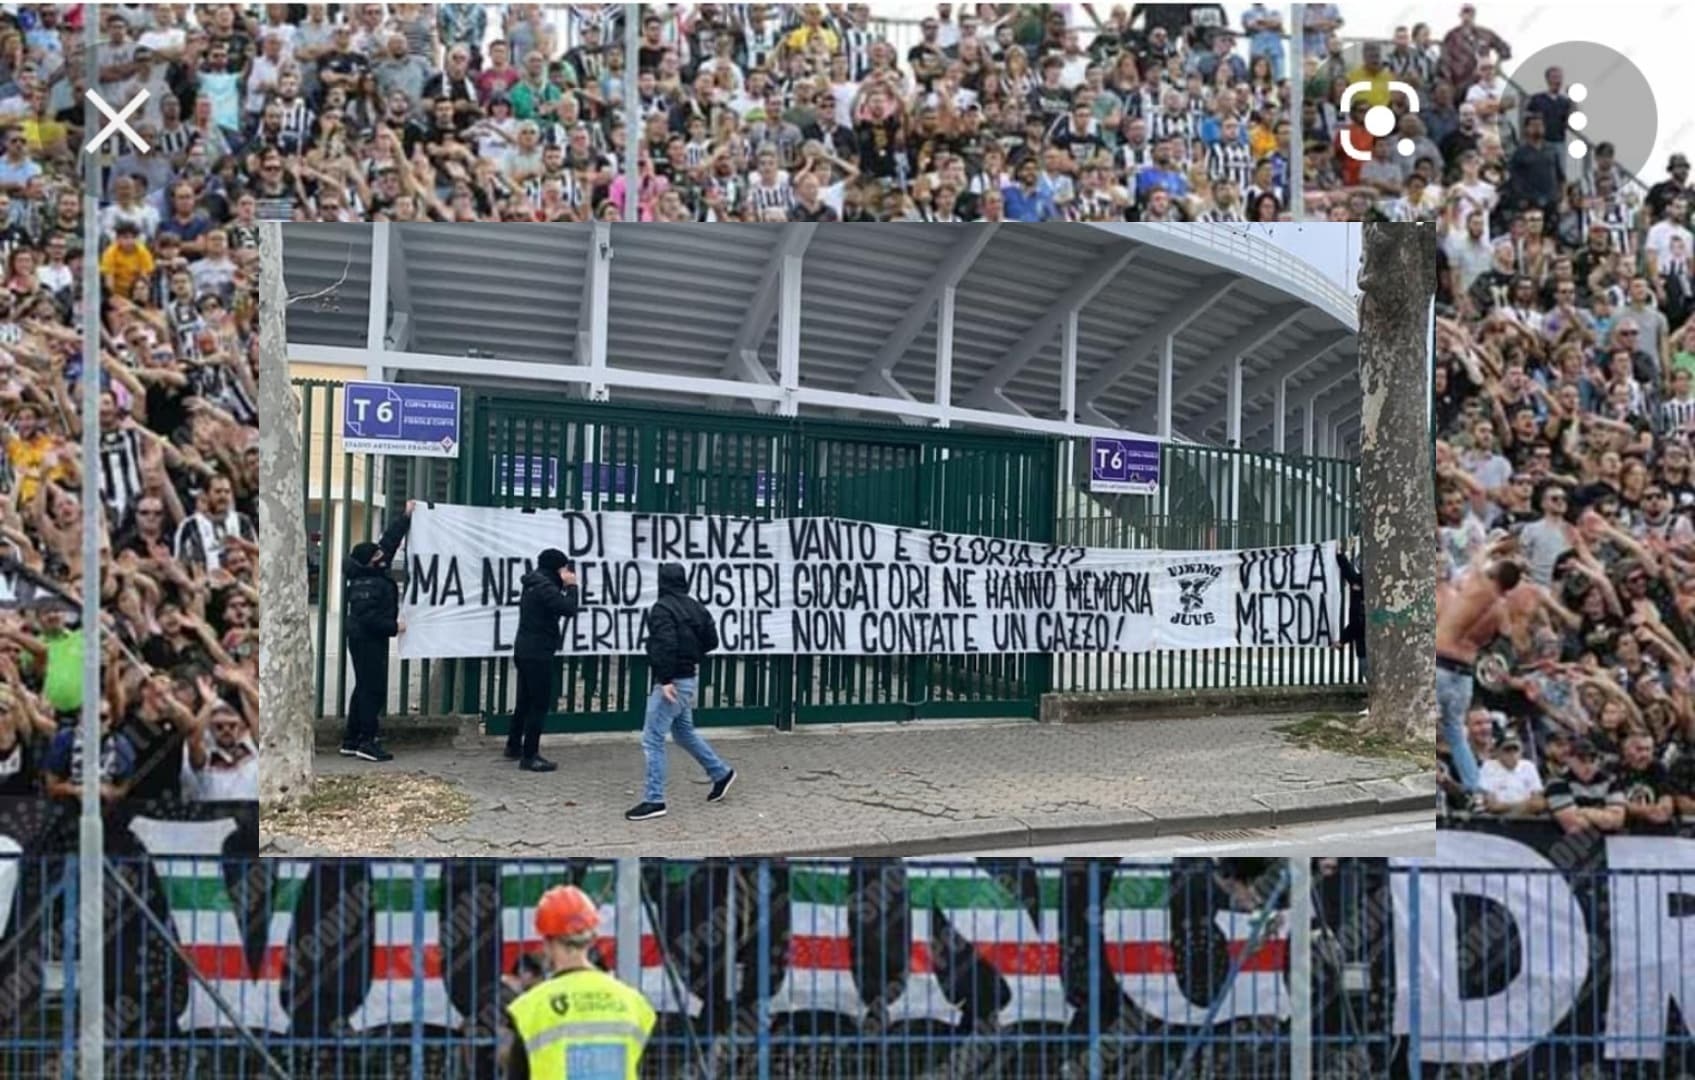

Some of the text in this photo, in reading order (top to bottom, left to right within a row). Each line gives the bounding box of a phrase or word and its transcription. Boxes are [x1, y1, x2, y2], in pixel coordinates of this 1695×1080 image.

[353, 398, 393, 423] T 6
[562, 512, 605, 557] DI
[631, 514, 773, 560] FIRENZE
[789, 517, 876, 561] VANTO
[894, 528, 912, 562] E
[928, 532, 1034, 567] GLORIA
[410, 553, 465, 606] MA
[481, 556, 642, 607] NEENO
[793, 562, 930, 610] GIOCATORI
[942, 565, 977, 608] NE
[985, 567, 1057, 610] HANNO
[1065, 568, 1154, 615] MEMORIA
[1167, 562, 1223, 578] VIKING
[1237, 543, 1328, 591] VIOLA
[720, 608, 776, 651] CHE
[792, 609, 847, 652] NON
[860, 610, 979, 654] CONTATE
[993, 613, 1027, 652] UN
[1170, 611, 1216, 626] JUVE
[1235, 592, 1332, 646] MERDA
